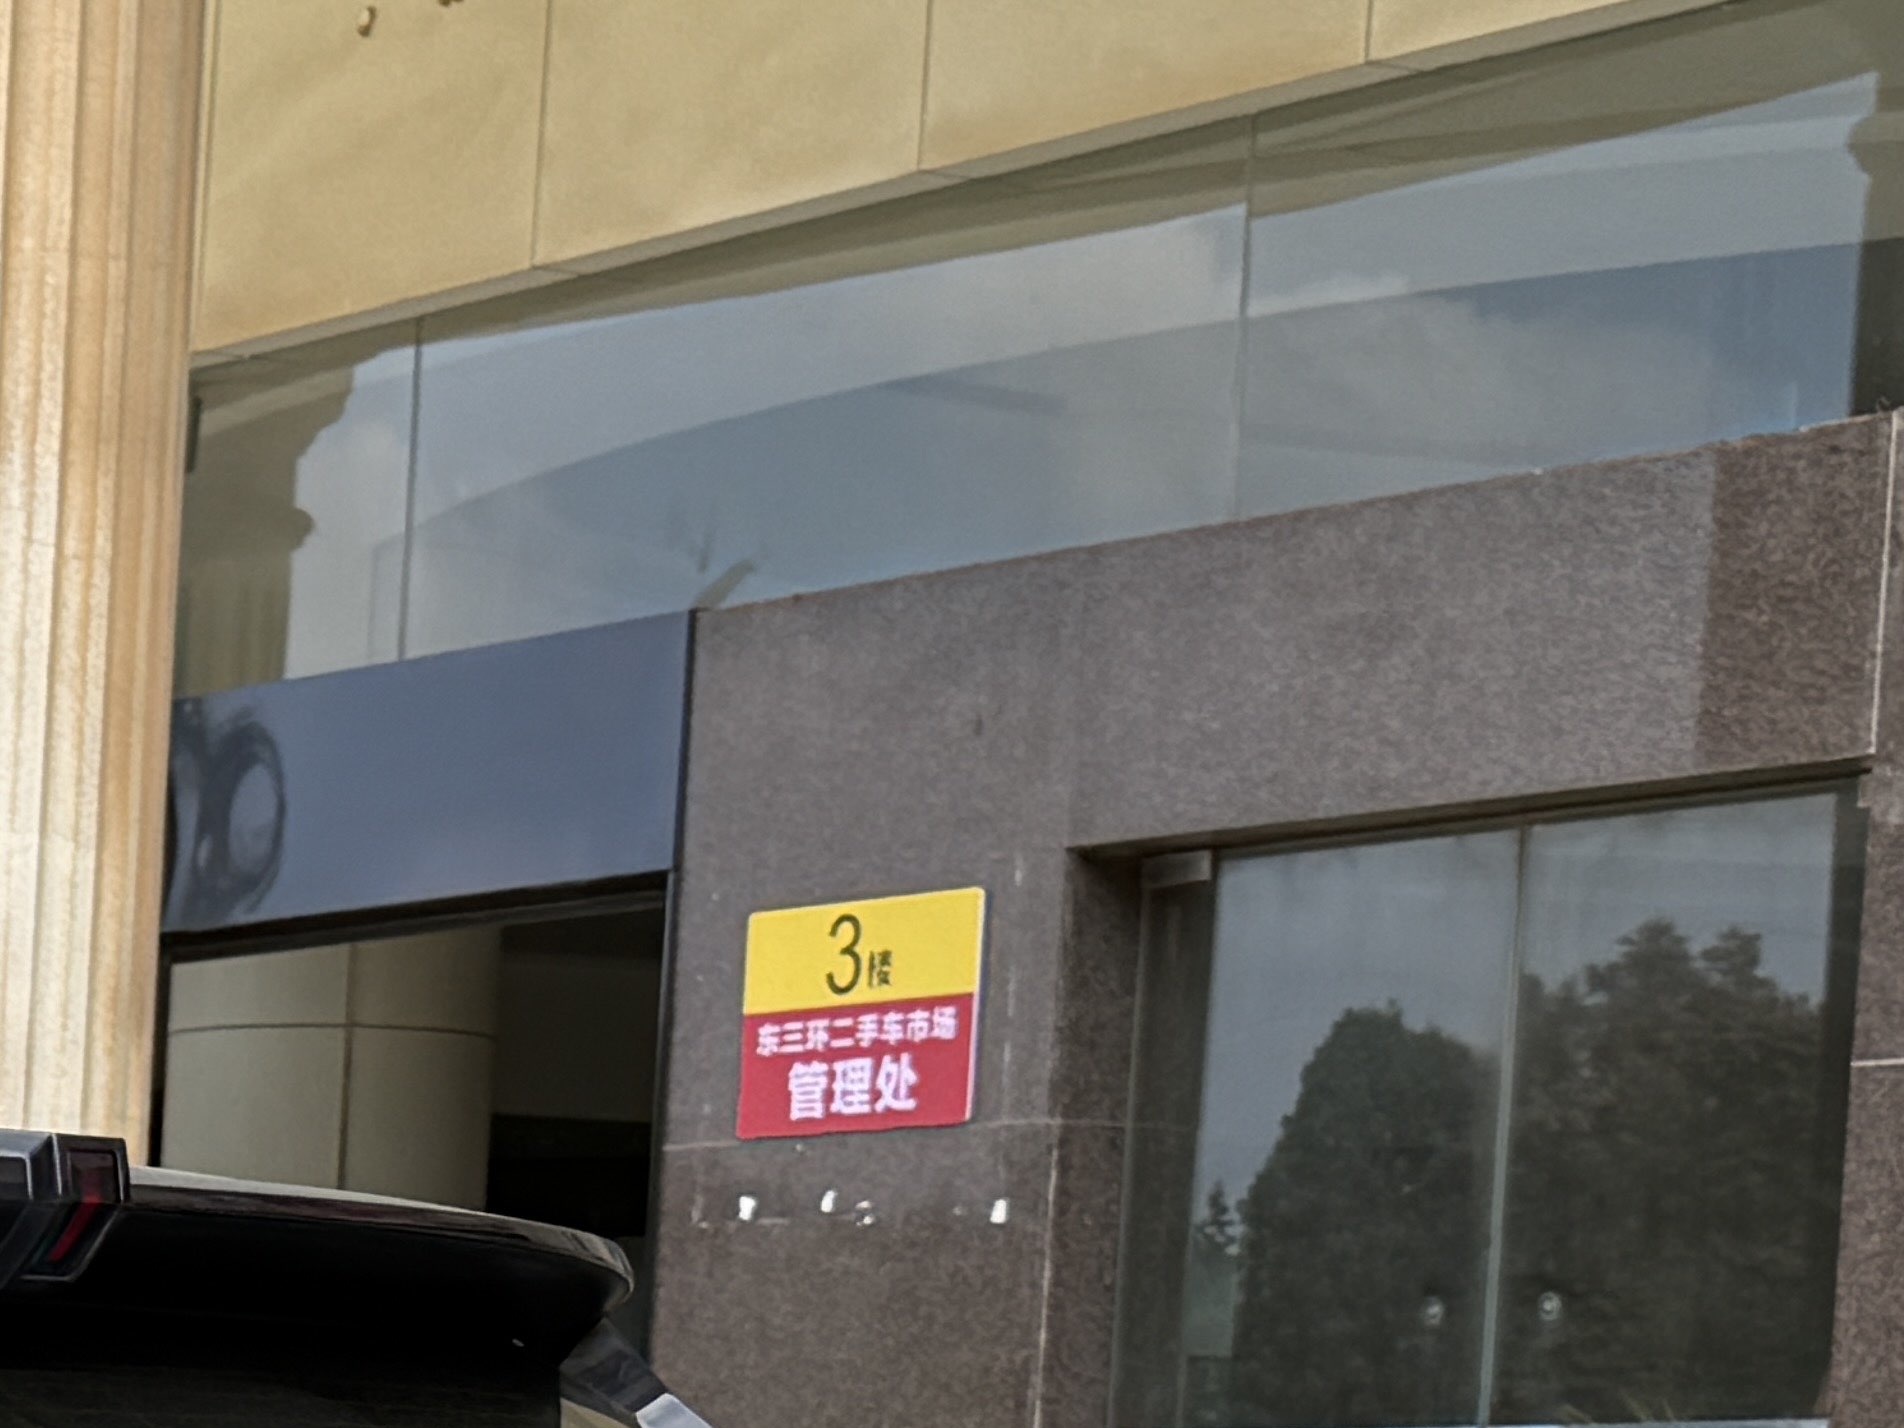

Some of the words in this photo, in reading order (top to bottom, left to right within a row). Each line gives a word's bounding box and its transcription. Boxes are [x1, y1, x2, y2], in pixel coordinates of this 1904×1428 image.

[756, 1005, 958, 1057] 东三环二手车市场
[787, 1052, 919, 1121] 管理处
